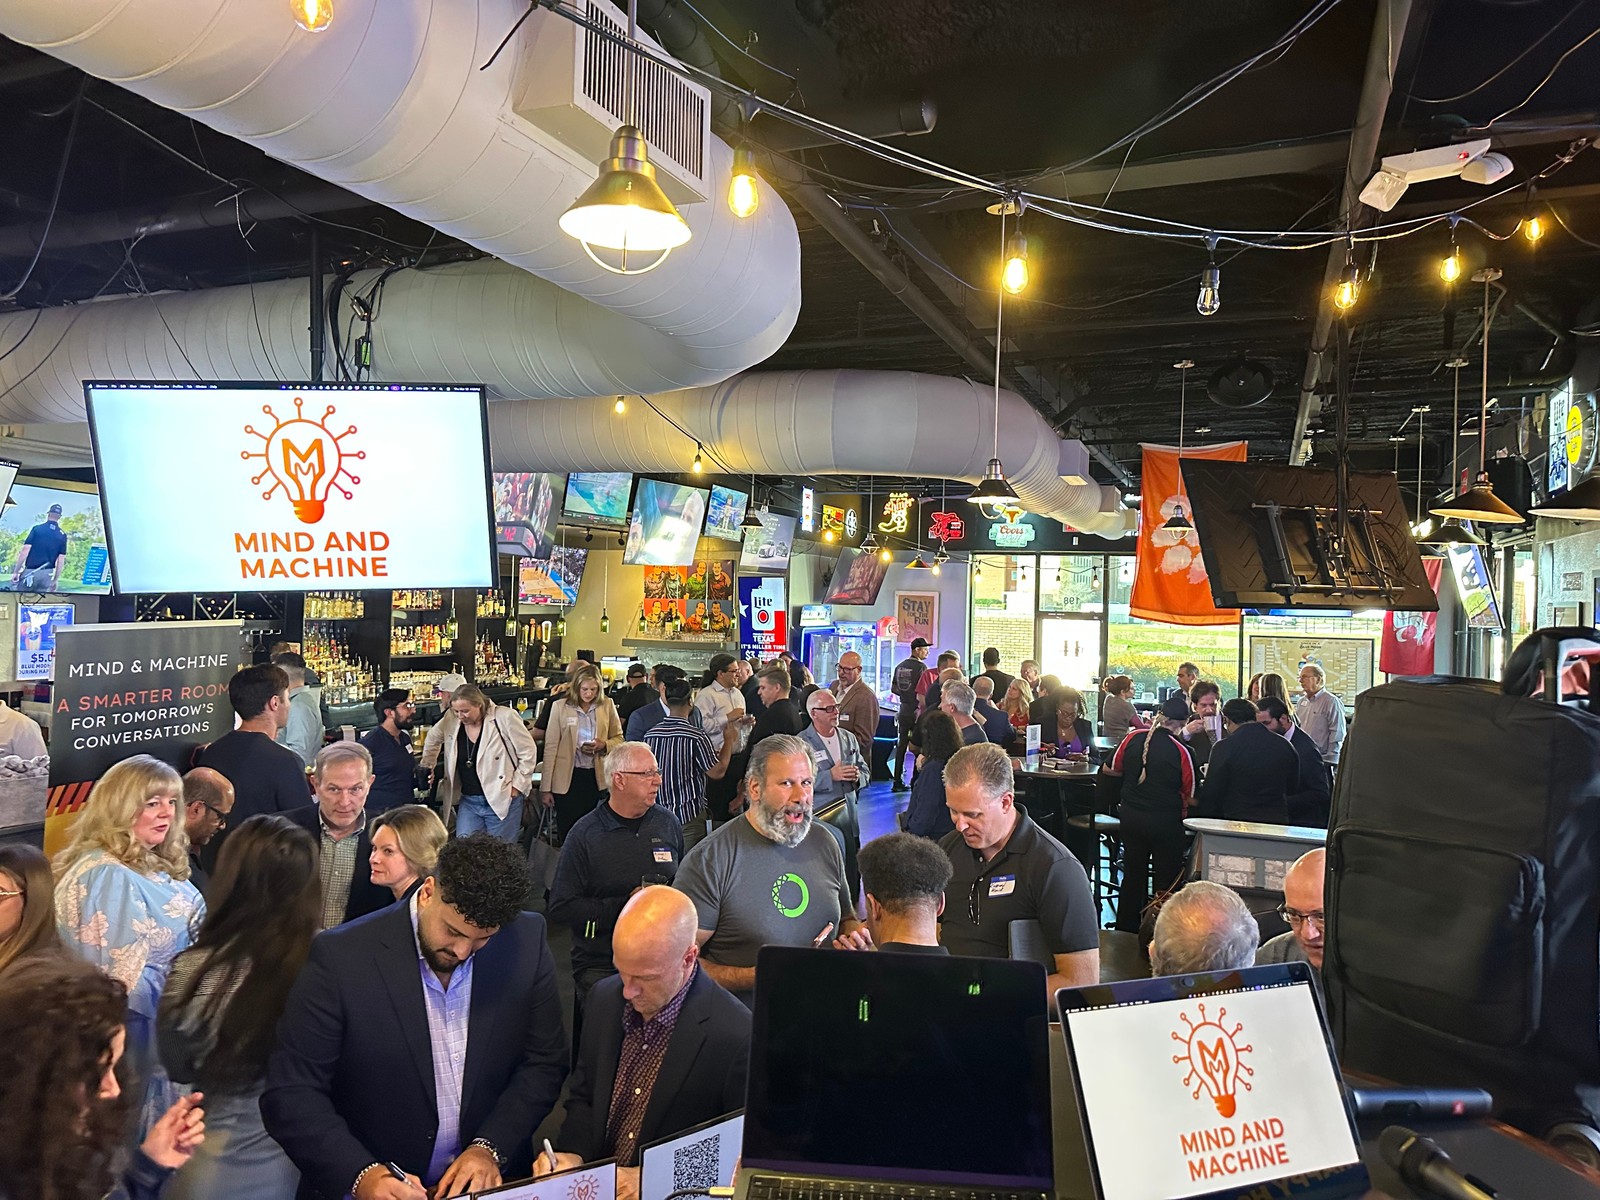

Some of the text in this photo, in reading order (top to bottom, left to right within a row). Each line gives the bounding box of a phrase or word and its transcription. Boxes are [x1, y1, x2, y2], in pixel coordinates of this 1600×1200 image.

[1000, 525, 1024, 534] Coors
[234, 531, 390, 553] MIND AND
[240, 557, 388, 578] MACHINE
[753, 596, 773, 609] Lite
[902, 597, 931, 612] STAY
[914, 617, 929, 625] FUN
[753, 635, 775, 643] TEXAS
[31, 653, 53, 663] $5.0
[69, 654, 229, 678] MIND & MACHINE
[57, 683, 230, 713] A SMARTER ROOM
[71, 703, 214, 730] FOR TOMORROW'S
[73, 721, 210, 750] CONVERSATIONS
[1180, 1118, 1284, 1155] MIND AND
[1188, 1143, 1289, 1181] MACHINE
